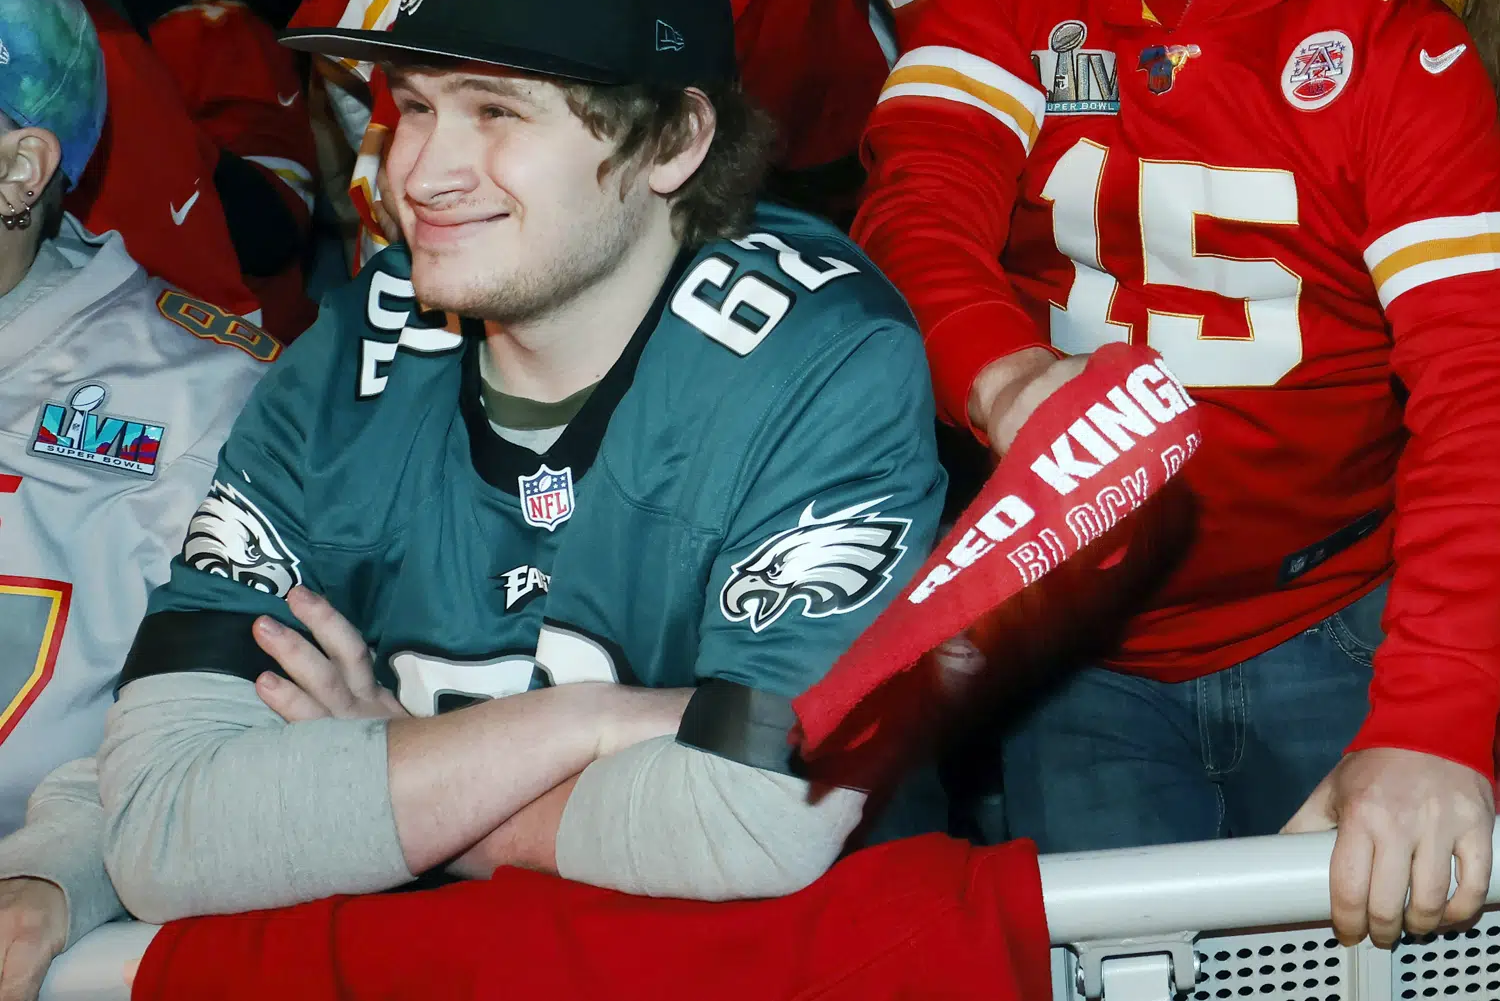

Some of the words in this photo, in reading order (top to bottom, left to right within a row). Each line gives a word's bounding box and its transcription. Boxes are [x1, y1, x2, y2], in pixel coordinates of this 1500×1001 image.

[1046, 100, 1077, 112] UPER
[1082, 101, 1115, 111] BOWL
[1039, 137, 1302, 388] 15
[47, 444, 96, 460] SUPER
[103, 456, 143, 470] BOWL
[529, 491, 568, 519] NFL
